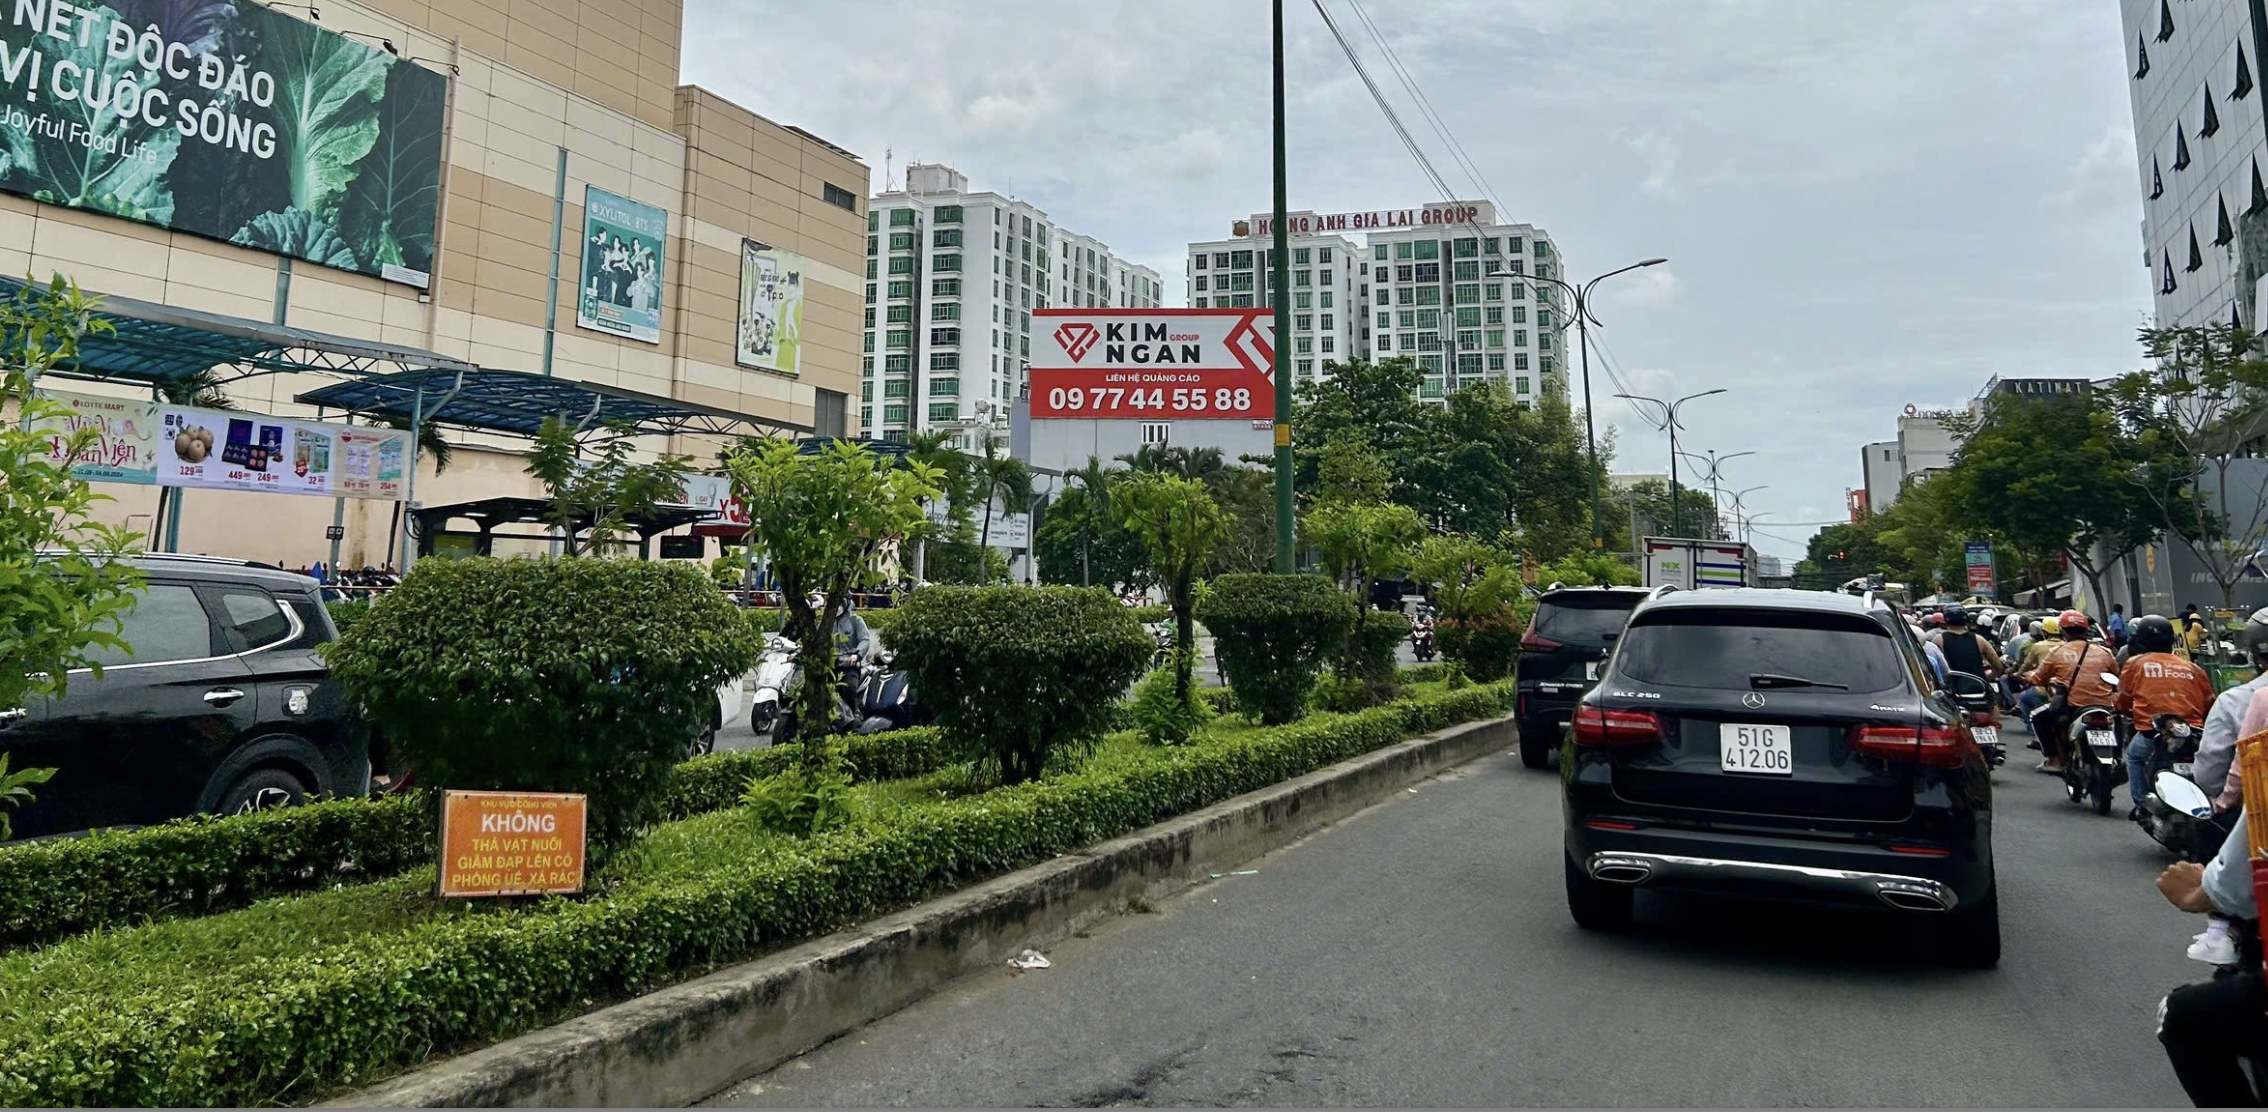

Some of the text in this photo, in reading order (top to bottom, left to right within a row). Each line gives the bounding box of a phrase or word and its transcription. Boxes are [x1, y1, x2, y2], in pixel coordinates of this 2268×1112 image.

[107, 23, 192, 80] ĐỘC
[198, 54, 275, 108] ĐÁO
[51, 60, 169, 128] CUỘC
[175, 98, 276, 159] SỐNG
[1, 104, 157, 164] Joyful Food Life
[599, 204, 631, 226] XYLITOL
[1258, 207, 1478, 235] HONG ANH GIA LAI GROUP
[1106, 322, 1200, 342] KIM GROUP
[1106, 344, 1200, 364] NGAN
[1105, 372, 1201, 383] LIÊN HỆ QUẢNG CÁO
[2014, 381, 2083, 394] KATINAT
[80, 401, 125, 412] LOTTE MART
[1050, 388, 1251, 410] 09 77 44 55 88
[180, 466, 195, 476] 129
[229, 470, 243, 480] 449
[257, 472, 271, 482] 249
[308, 476, 317, 485] 32
[2164, 669, 2195, 680] Food
[1869, 704, 1906, 712] 4MATIC
[1738, 727, 1774, 747] 51G
[1725, 747, 1789, 769] 412.06
[481, 810, 556, 832] KHÔNG
[531, 837, 562, 851] NUÔI
[526, 854, 551, 868] LÊN
[451, 871, 501, 887] PHÓNG
[549, 869, 576, 884] RÁC
